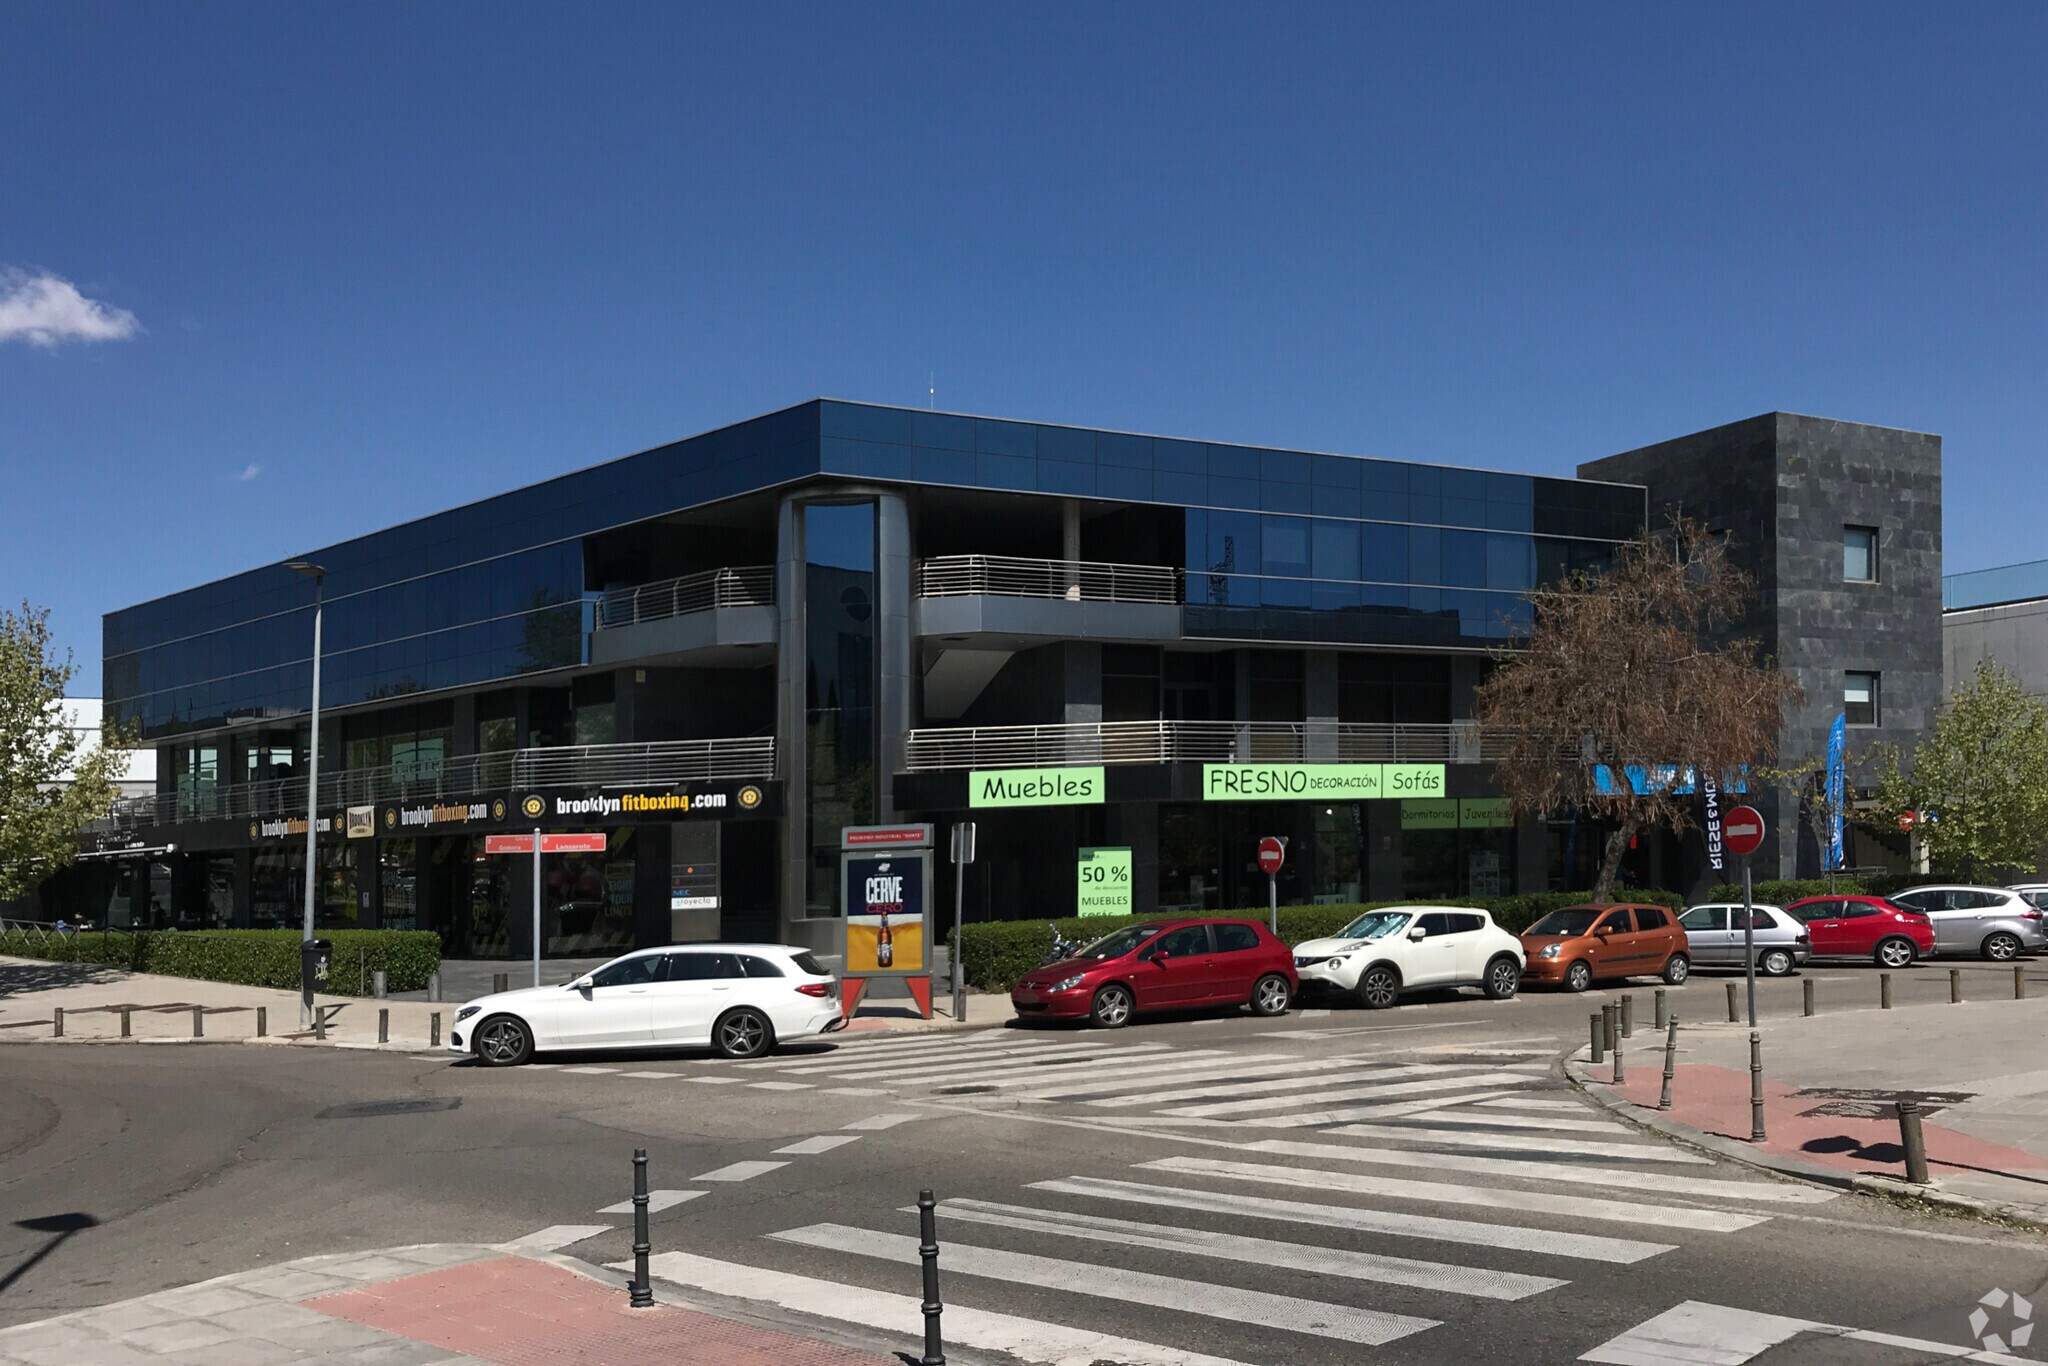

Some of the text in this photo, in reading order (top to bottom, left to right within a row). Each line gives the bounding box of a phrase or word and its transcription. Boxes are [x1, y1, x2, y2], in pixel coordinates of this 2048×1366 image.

[983, 774, 1092, 799] Muebles
[1210, 769, 1377, 794] FRESNO DECORACIÓN
[1392, 770, 1439, 790] Sofás
[401, 802, 487, 828] brooklynfitboxing.com
[1401, 809, 1455, 820] Dormitorios
[261, 816, 331, 839] brooklynfitboxicom
[1082, 865, 1128, 883] 50 %
[672, 889, 692, 897] NEC
[865, 876, 904, 904] CERVE
[866, 902, 904, 913] CERO
[1081, 896, 1128, 906] MUEBLES
